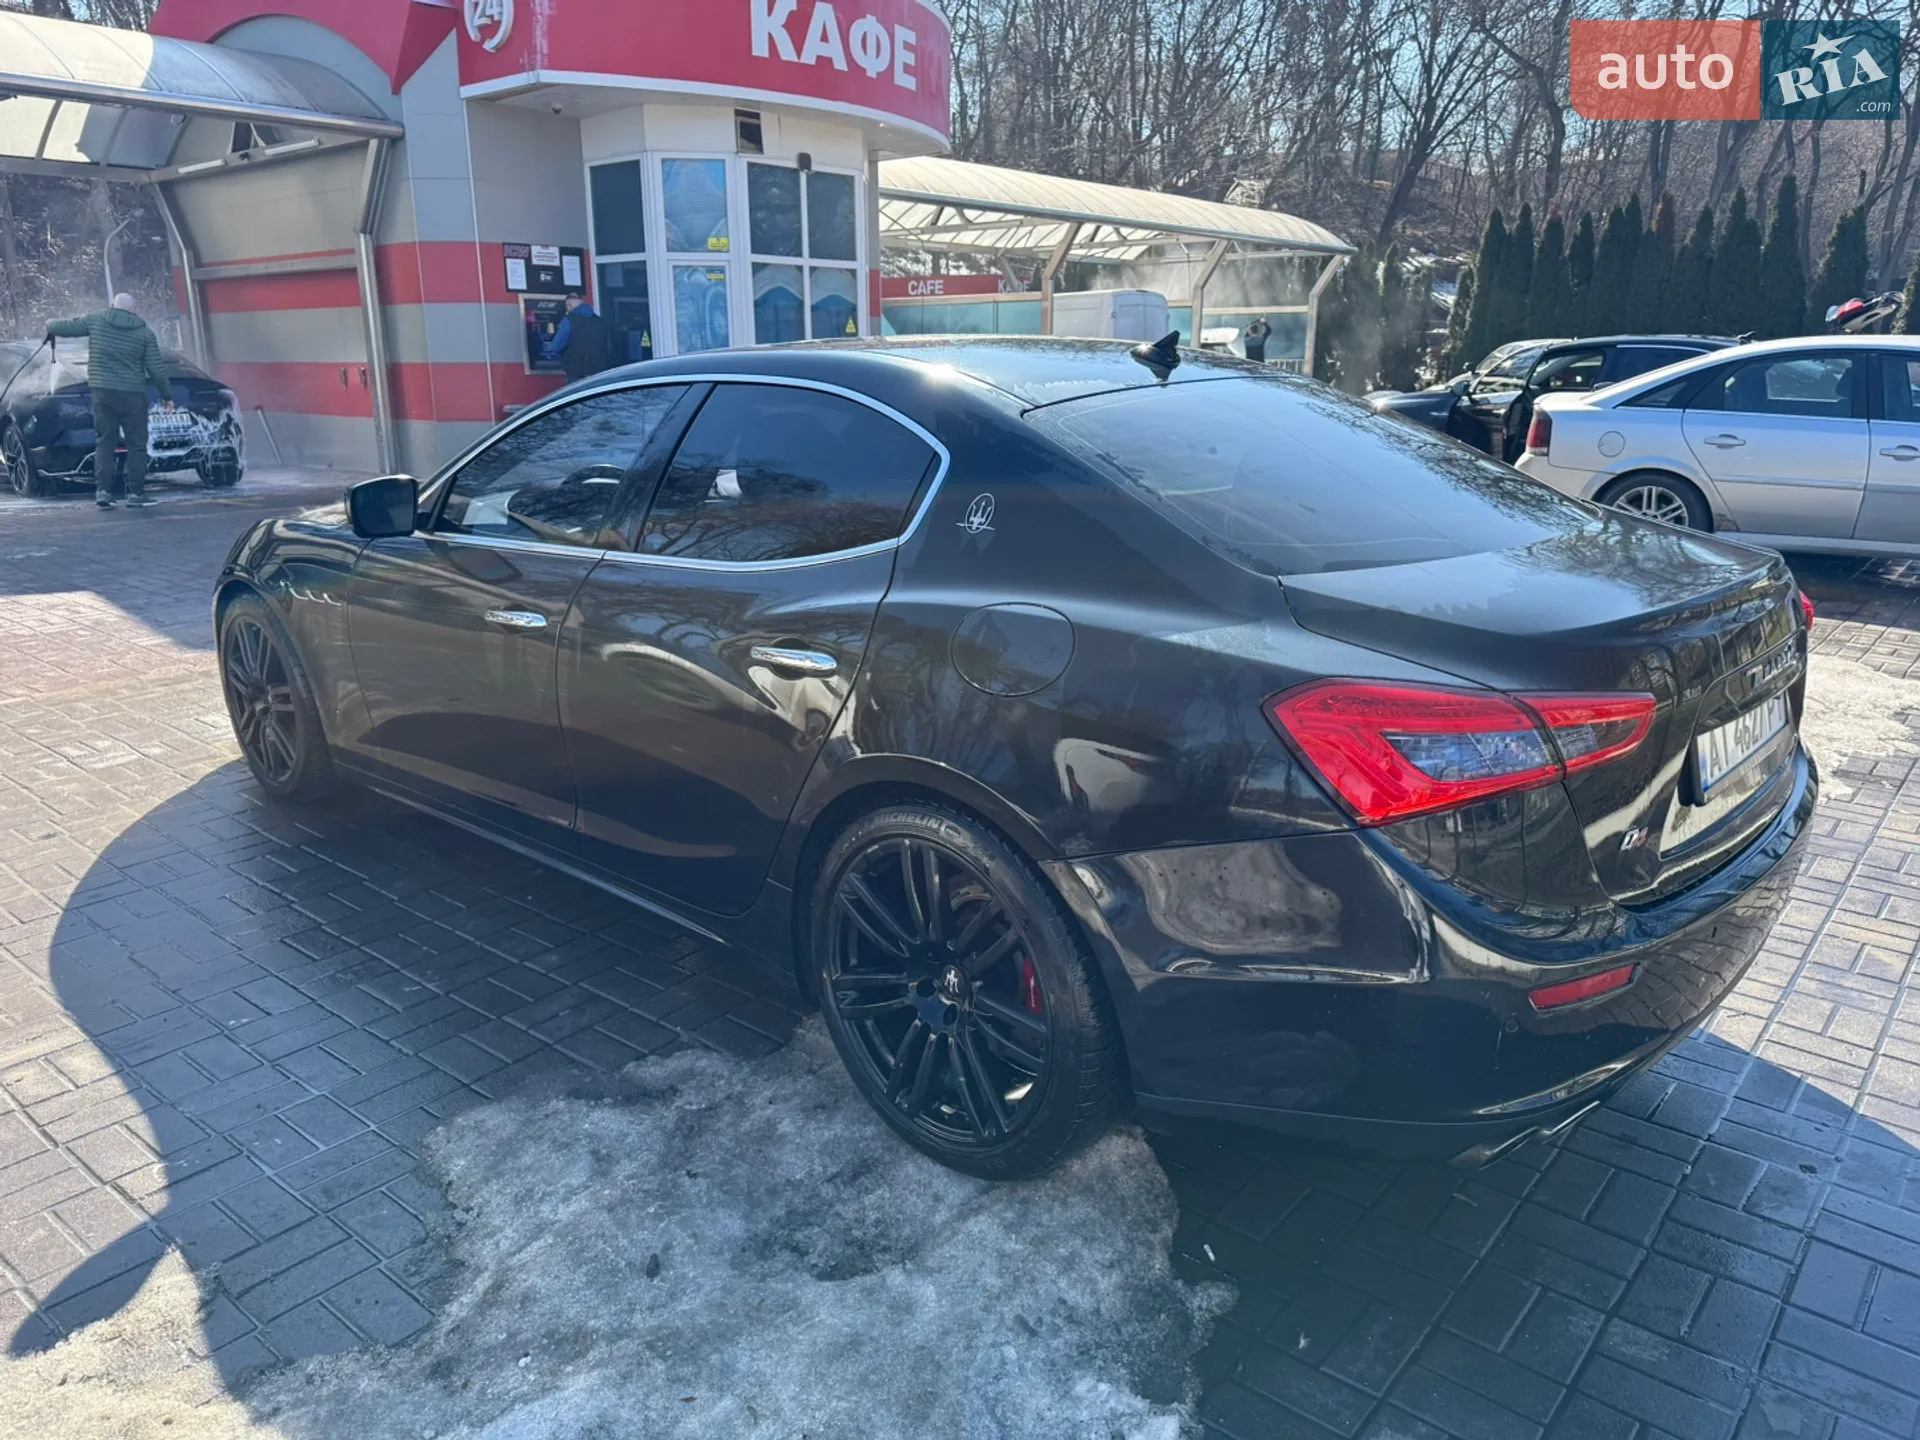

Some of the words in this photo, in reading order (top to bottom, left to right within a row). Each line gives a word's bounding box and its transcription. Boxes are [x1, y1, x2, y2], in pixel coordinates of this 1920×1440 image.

[750, 0, 917, 91] КАФЕ
[907, 279, 945, 296] CAFE
[873, 811, 941, 830] MICHELIN
